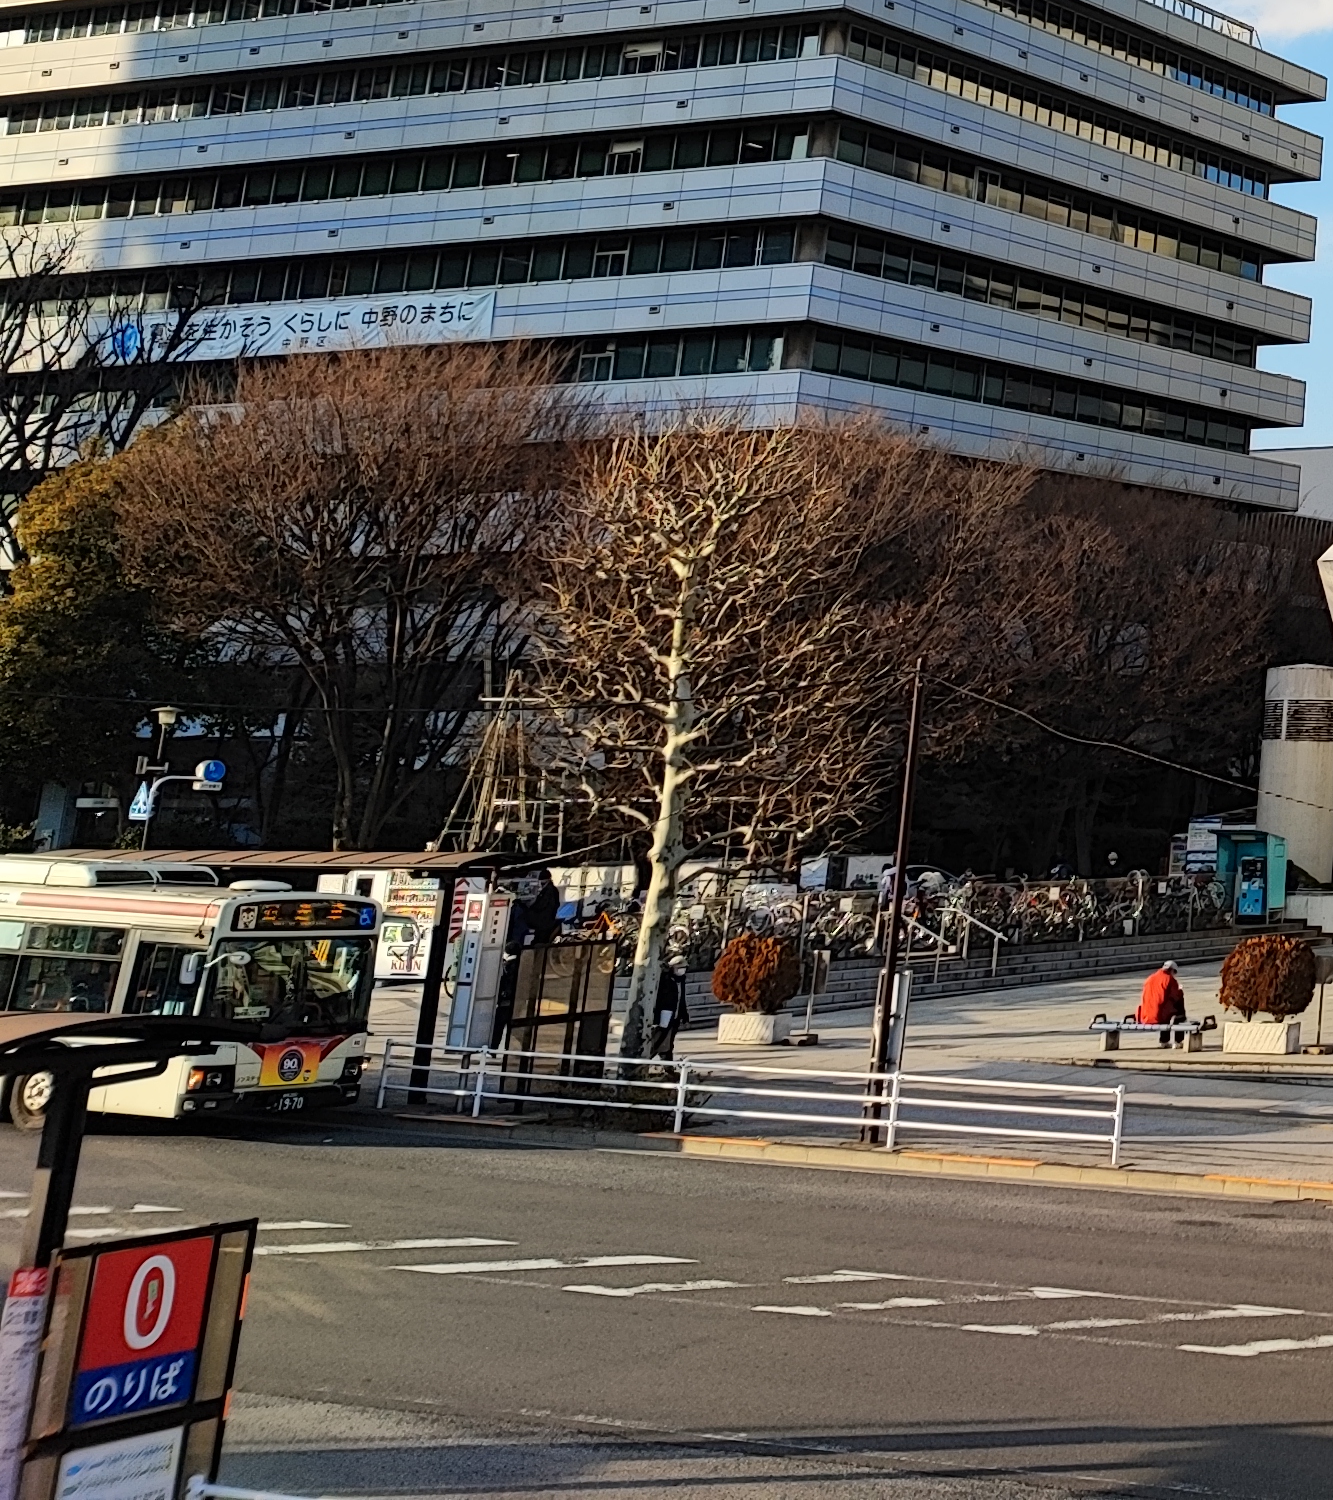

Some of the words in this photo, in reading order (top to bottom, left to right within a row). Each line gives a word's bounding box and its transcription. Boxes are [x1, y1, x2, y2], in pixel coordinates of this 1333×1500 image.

[283, 311, 348, 334] くらしに
[361, 301, 475, 329] 中野のまちに
[124, 1255, 175, 1350] 0
[84, 1357, 184, 1413] のりば
